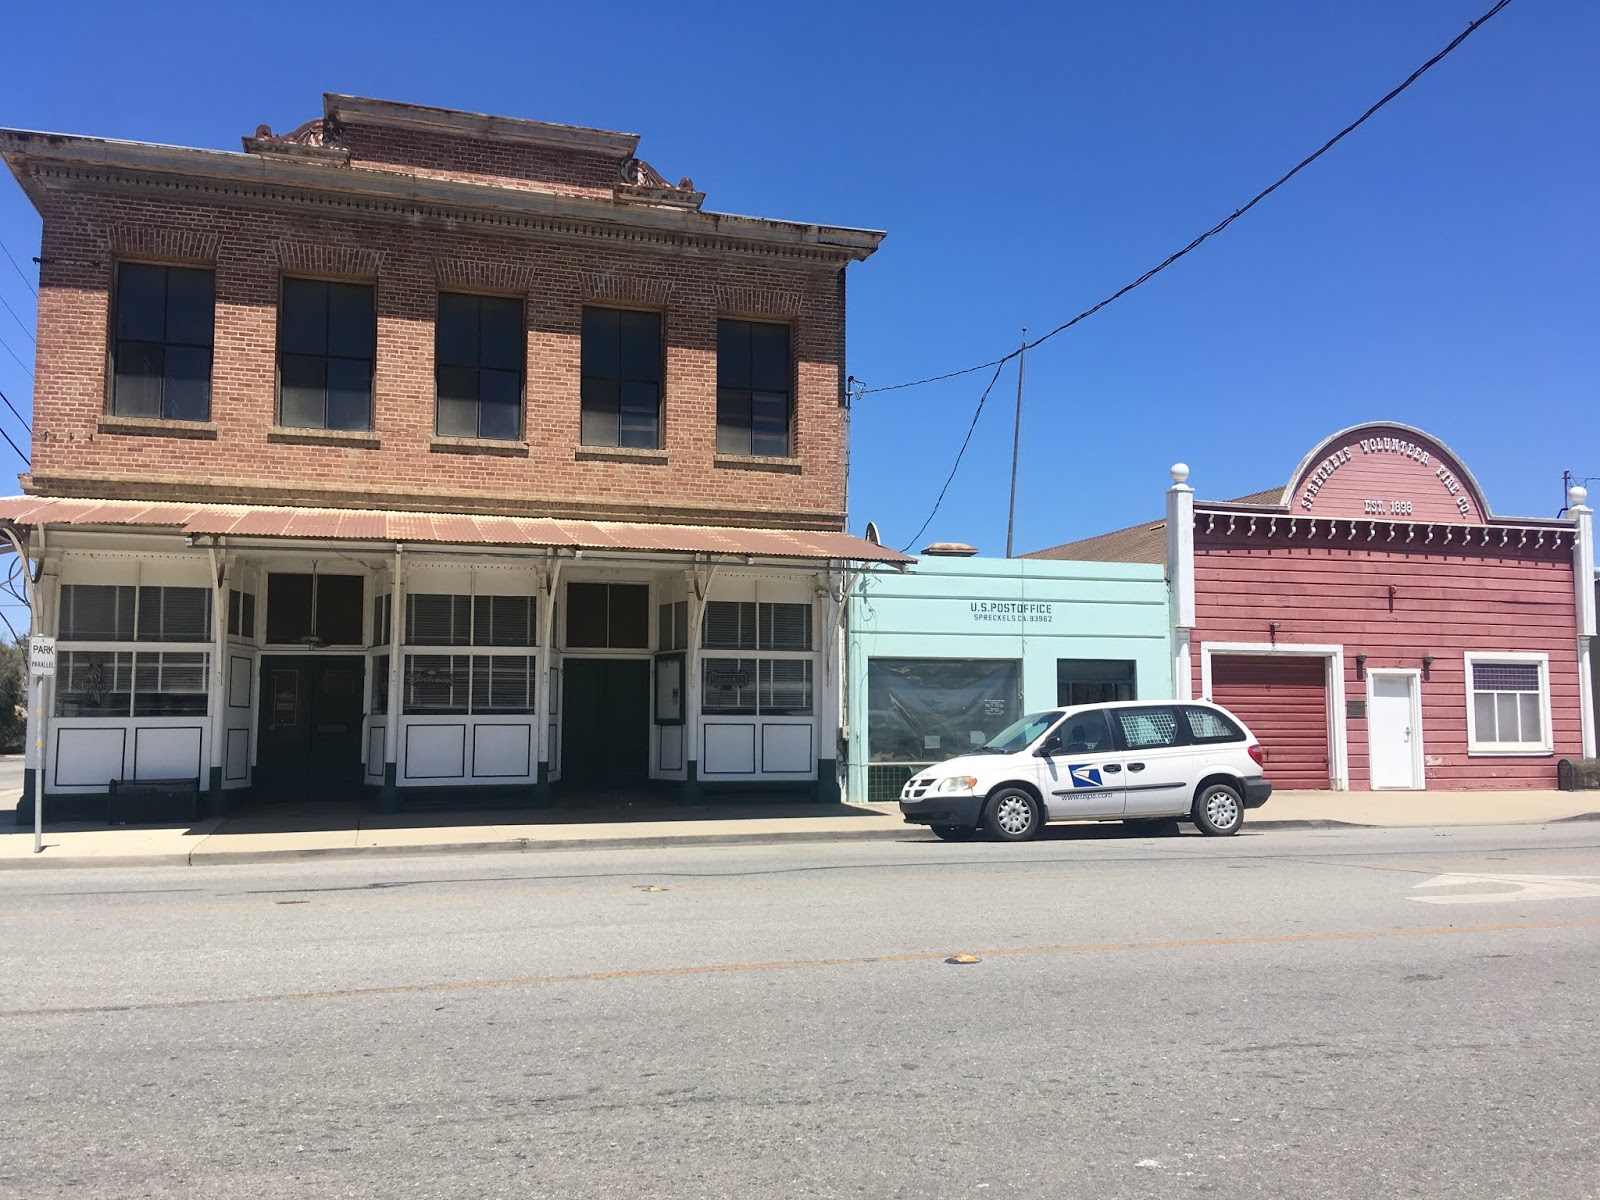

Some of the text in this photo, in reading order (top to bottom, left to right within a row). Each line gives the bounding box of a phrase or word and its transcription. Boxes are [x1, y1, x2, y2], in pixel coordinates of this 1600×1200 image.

[1300, 446, 1352, 511] SPRECKELS
[1359, 437, 1430, 467] VOLUNTEER
[1435, 464, 1460, 496] FIRE
[1364, 499, 1413, 515] EST. 1898
[974, 613, 1016, 622] SPRECKELS
[33, 645, 54, 655] PARK
[31, 661, 54, 669] PARALLEL
[1061, 791, 1113, 801] www.usps.com
